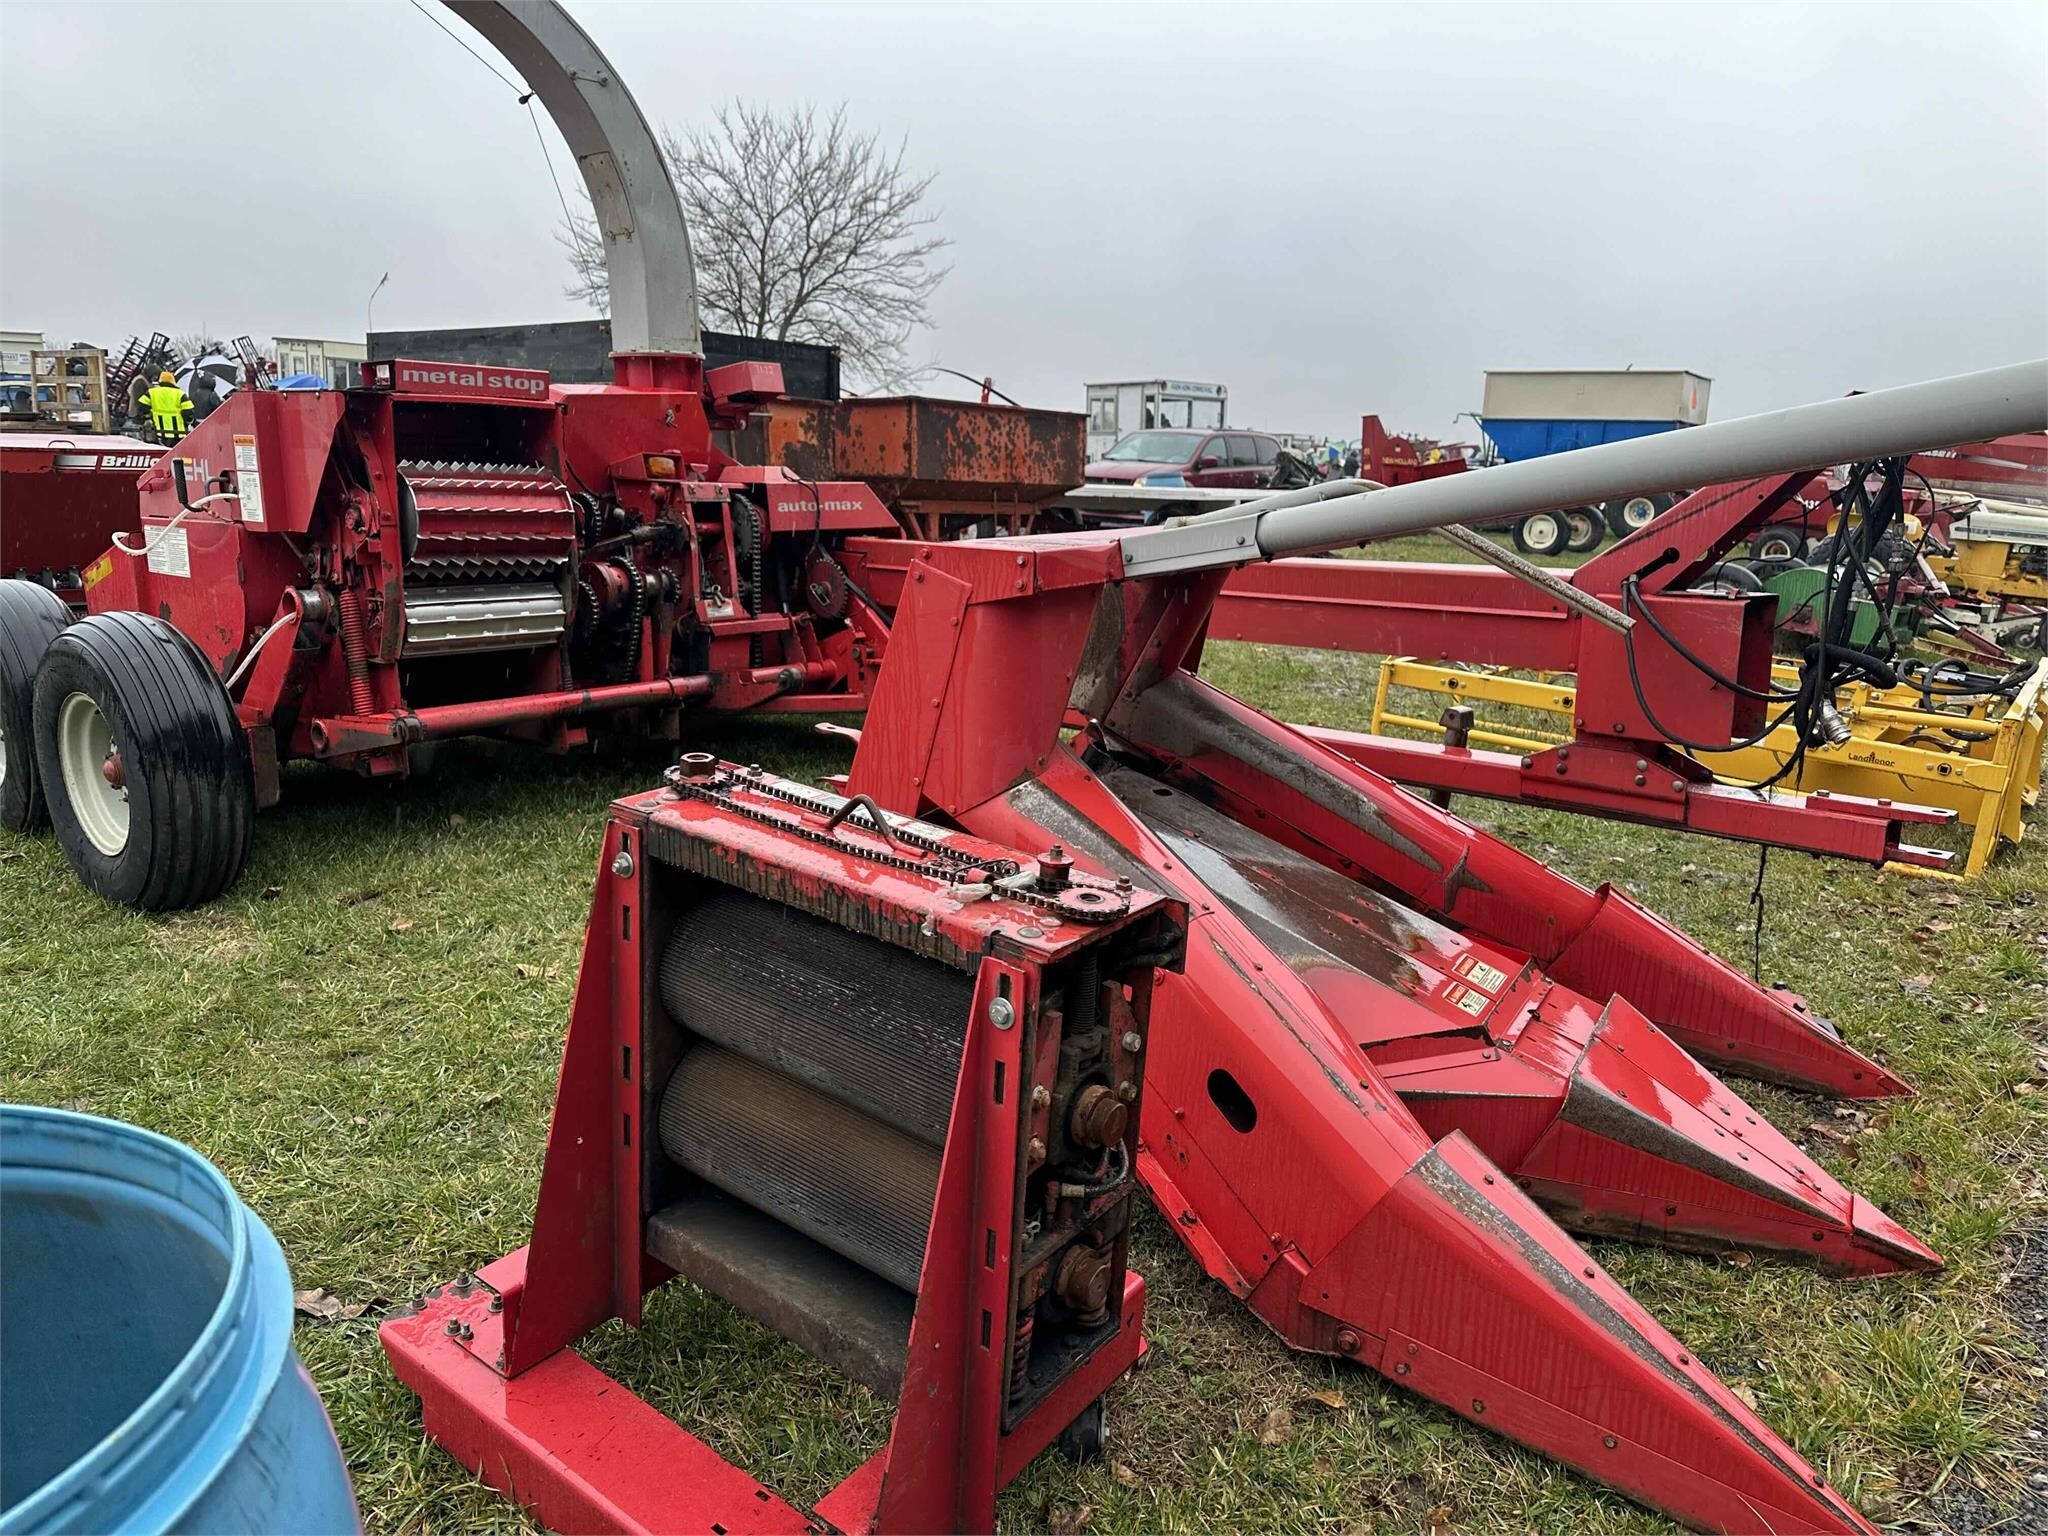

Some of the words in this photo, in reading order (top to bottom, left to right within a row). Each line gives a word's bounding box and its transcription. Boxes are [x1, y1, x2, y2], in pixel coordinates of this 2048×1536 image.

[402, 368, 483, 387] metal
[487, 373, 545, 395] stop
[777, 499, 863, 513] auto-max
